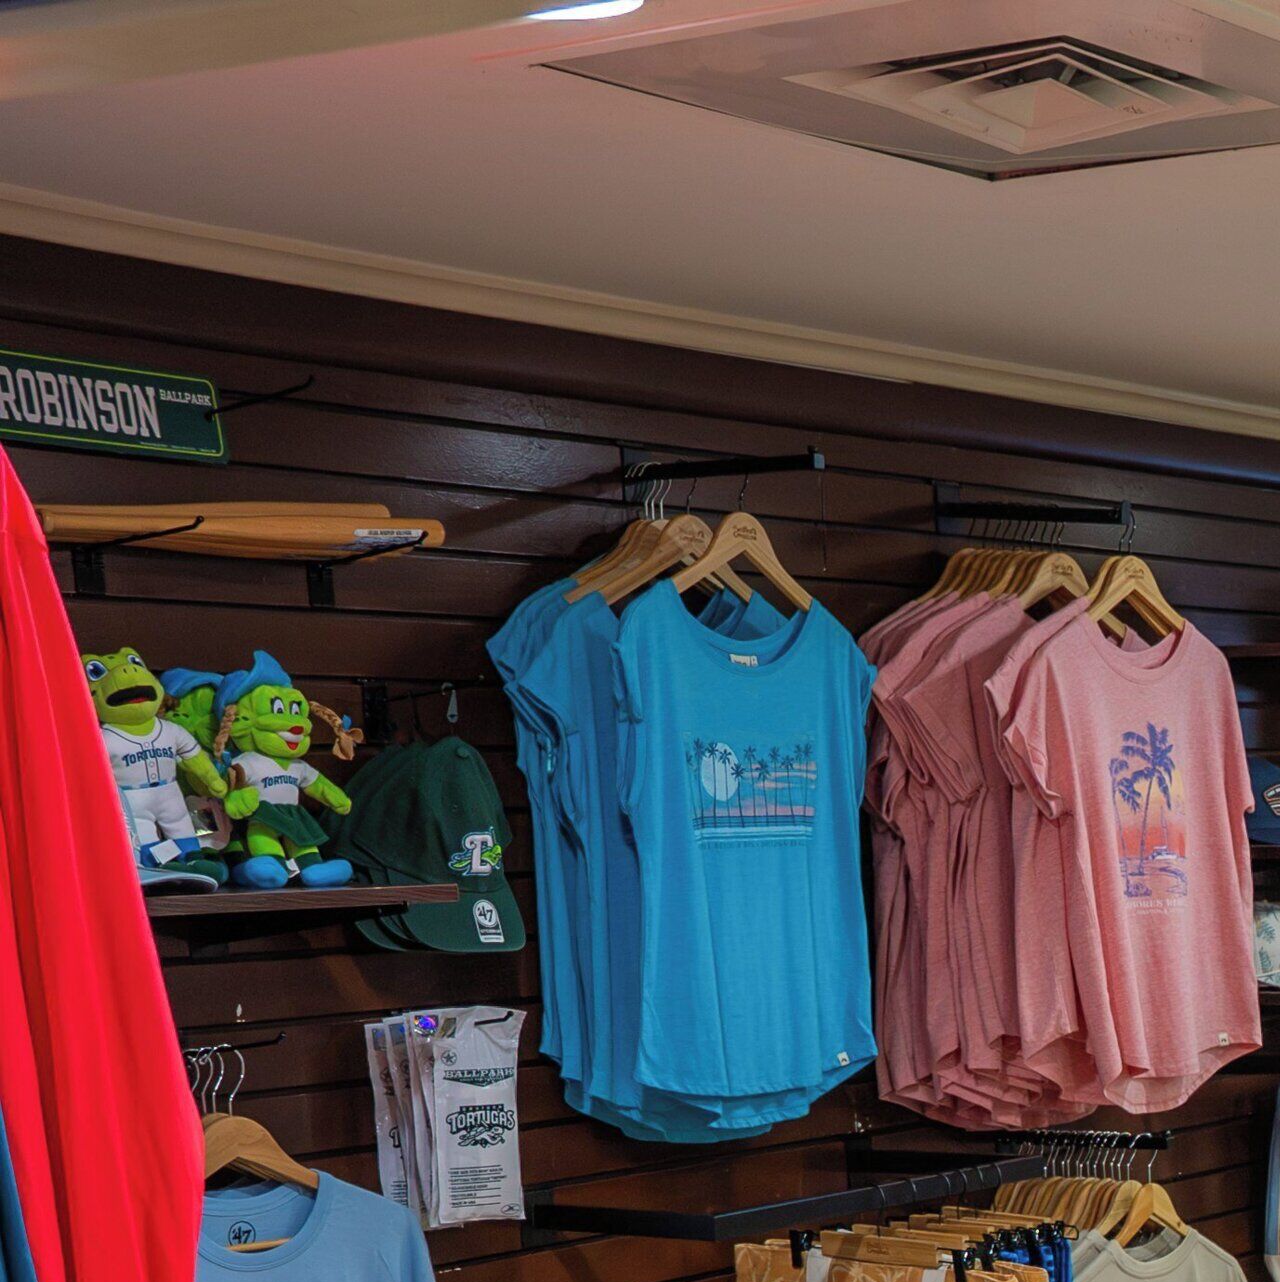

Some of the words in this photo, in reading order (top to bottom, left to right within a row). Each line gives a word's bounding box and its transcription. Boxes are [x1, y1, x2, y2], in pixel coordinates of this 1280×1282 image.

[0, 366, 161, 438] ROBINSON
[159, 388, 212, 406] BALLPARK
[122, 746, 176, 767] TORTUGAS
[443, 1067, 514, 1080] BALLPARK
[446, 1109, 515, 1134] TORTUGAS
